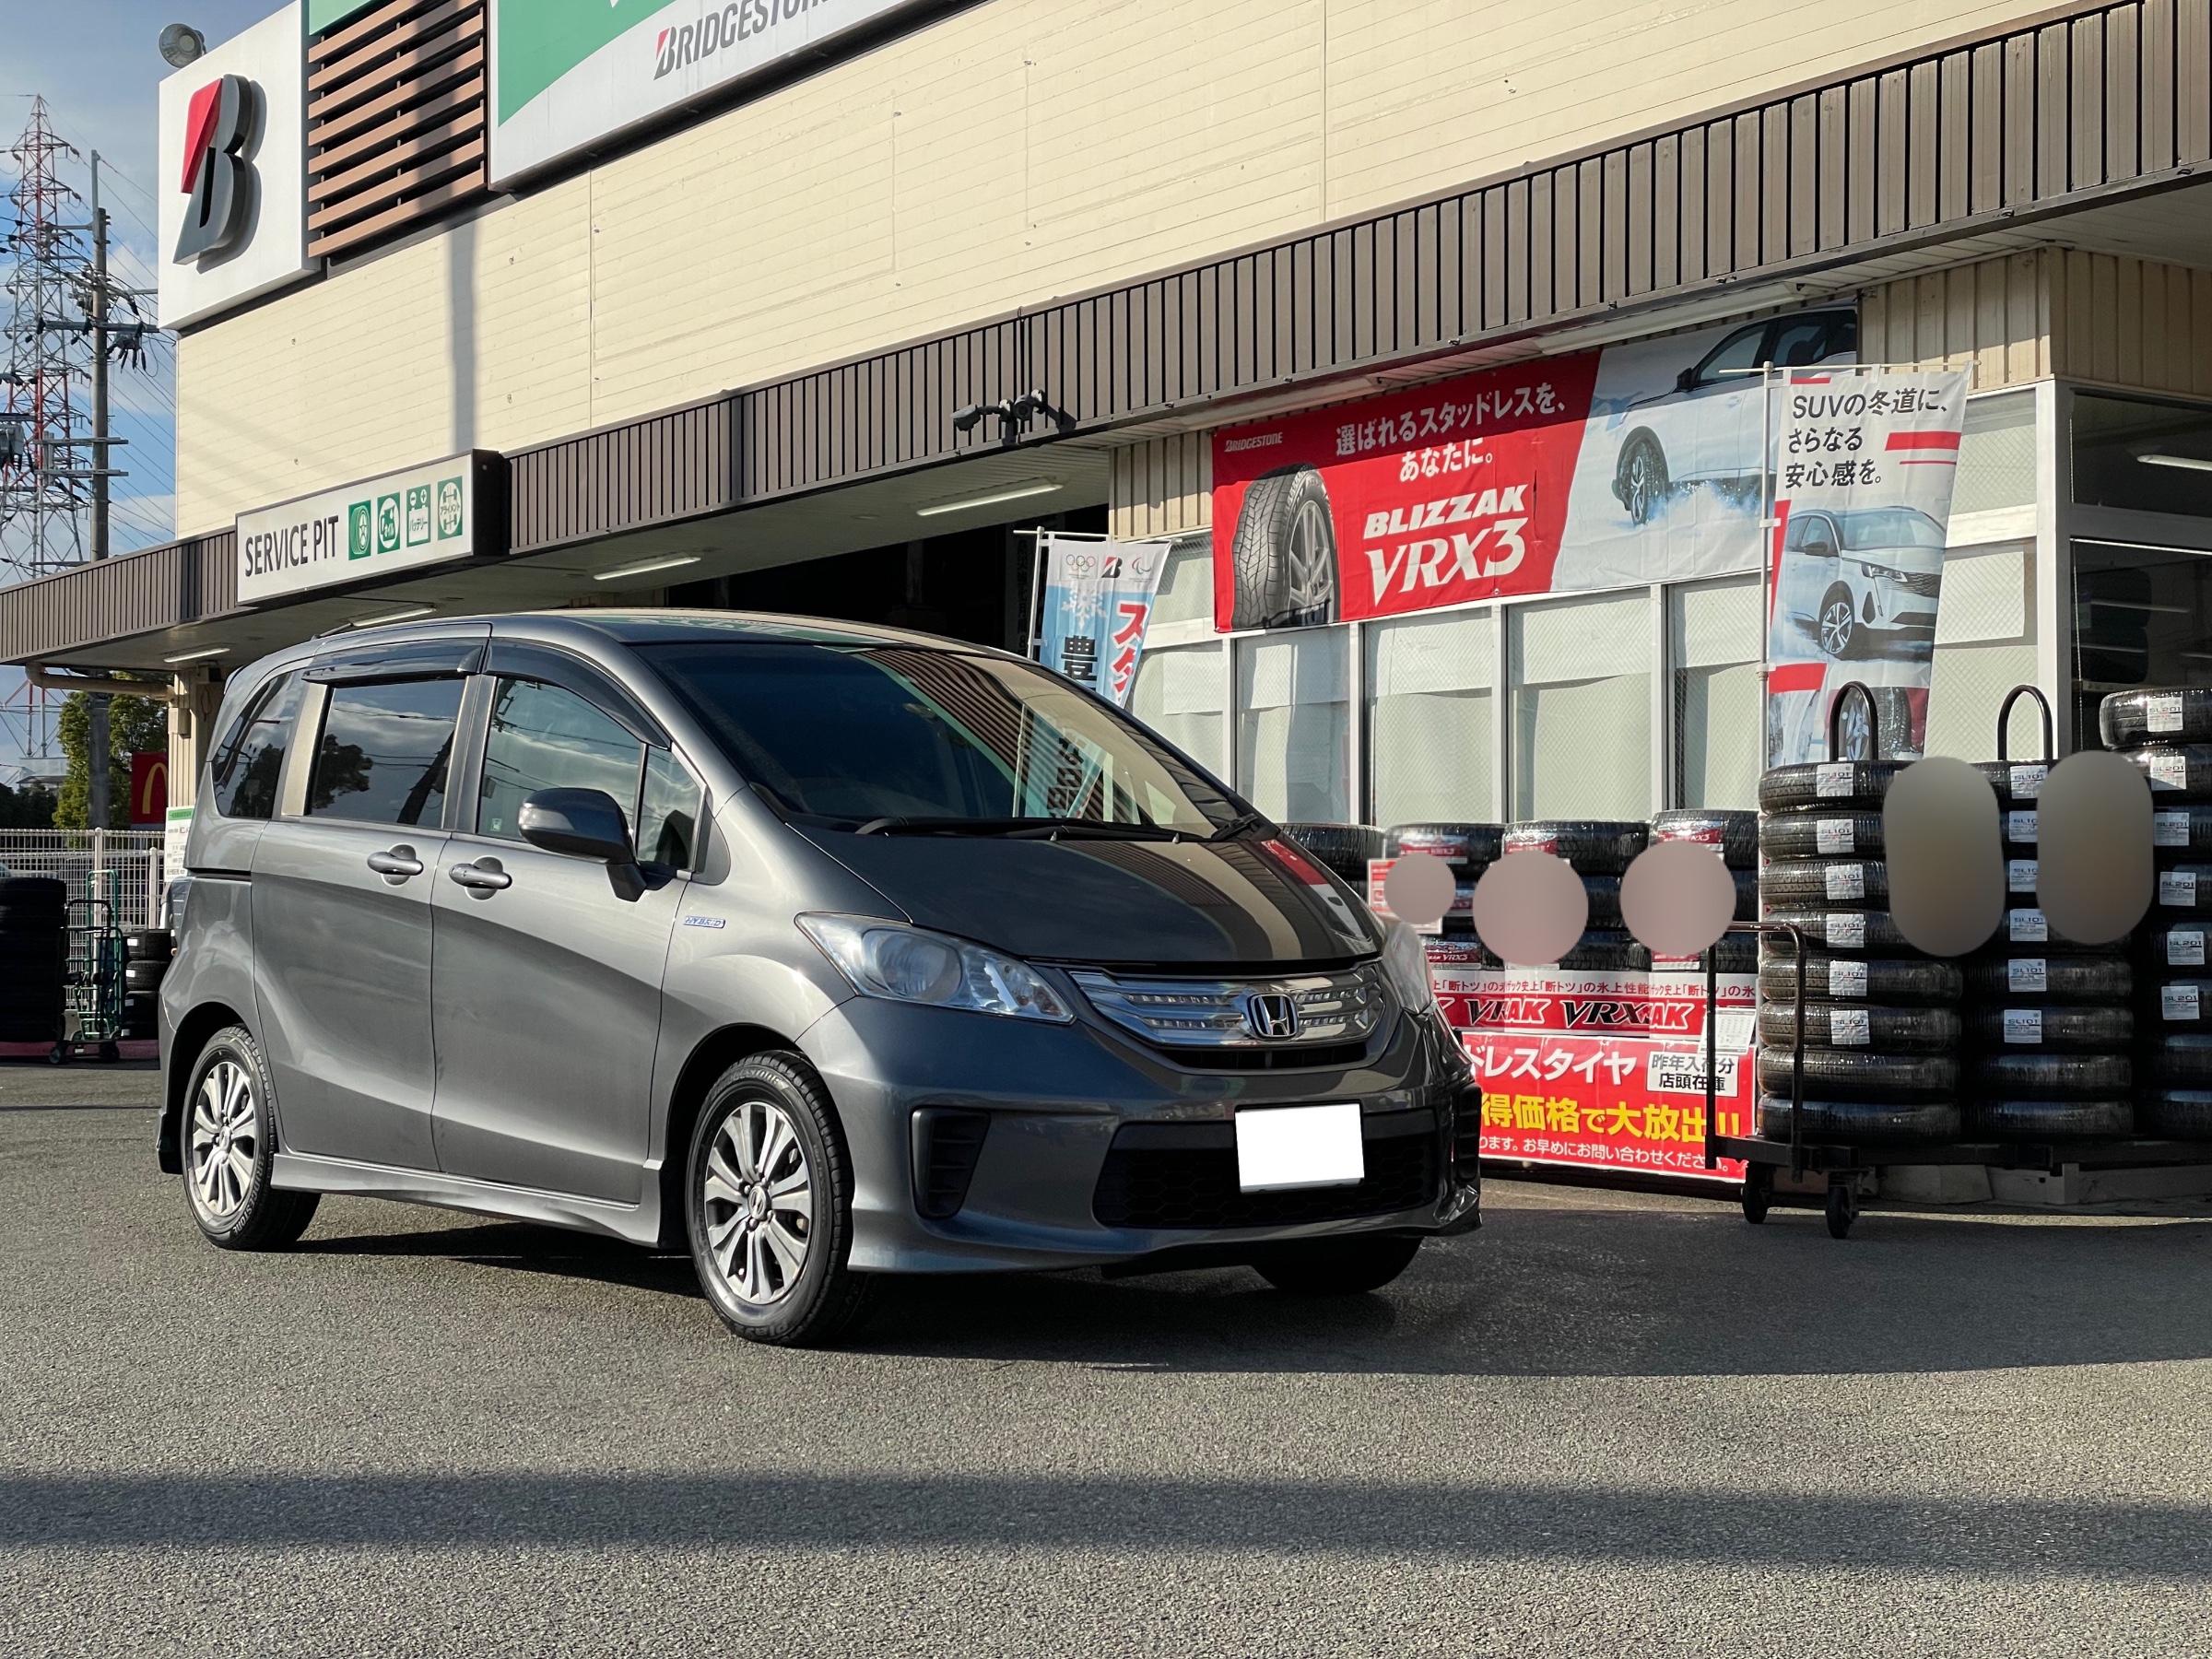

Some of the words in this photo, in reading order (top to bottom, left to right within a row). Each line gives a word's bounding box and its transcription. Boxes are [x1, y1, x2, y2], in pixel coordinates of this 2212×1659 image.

[653, 0, 831, 81] BRIDGEST
[1335, 382, 1565, 456] 選ばれるスタッドレスを、
[1792, 387, 1947, 419] SUVの冬道に、
[1224, 431, 1283, 453] BRIDGESTONE
[1399, 437, 1493, 482] あなたに。
[1788, 426, 1864, 453] さらなる
[1785, 459, 1882, 489] 安心感を。
[1363, 484, 1528, 539] BLIZZAK
[244, 523, 309, 578] SERVICE
[313, 514, 339, 561] PIT
[1364, 517, 1528, 606] VRX3
[685, 917, 722, 927] HYBRID
